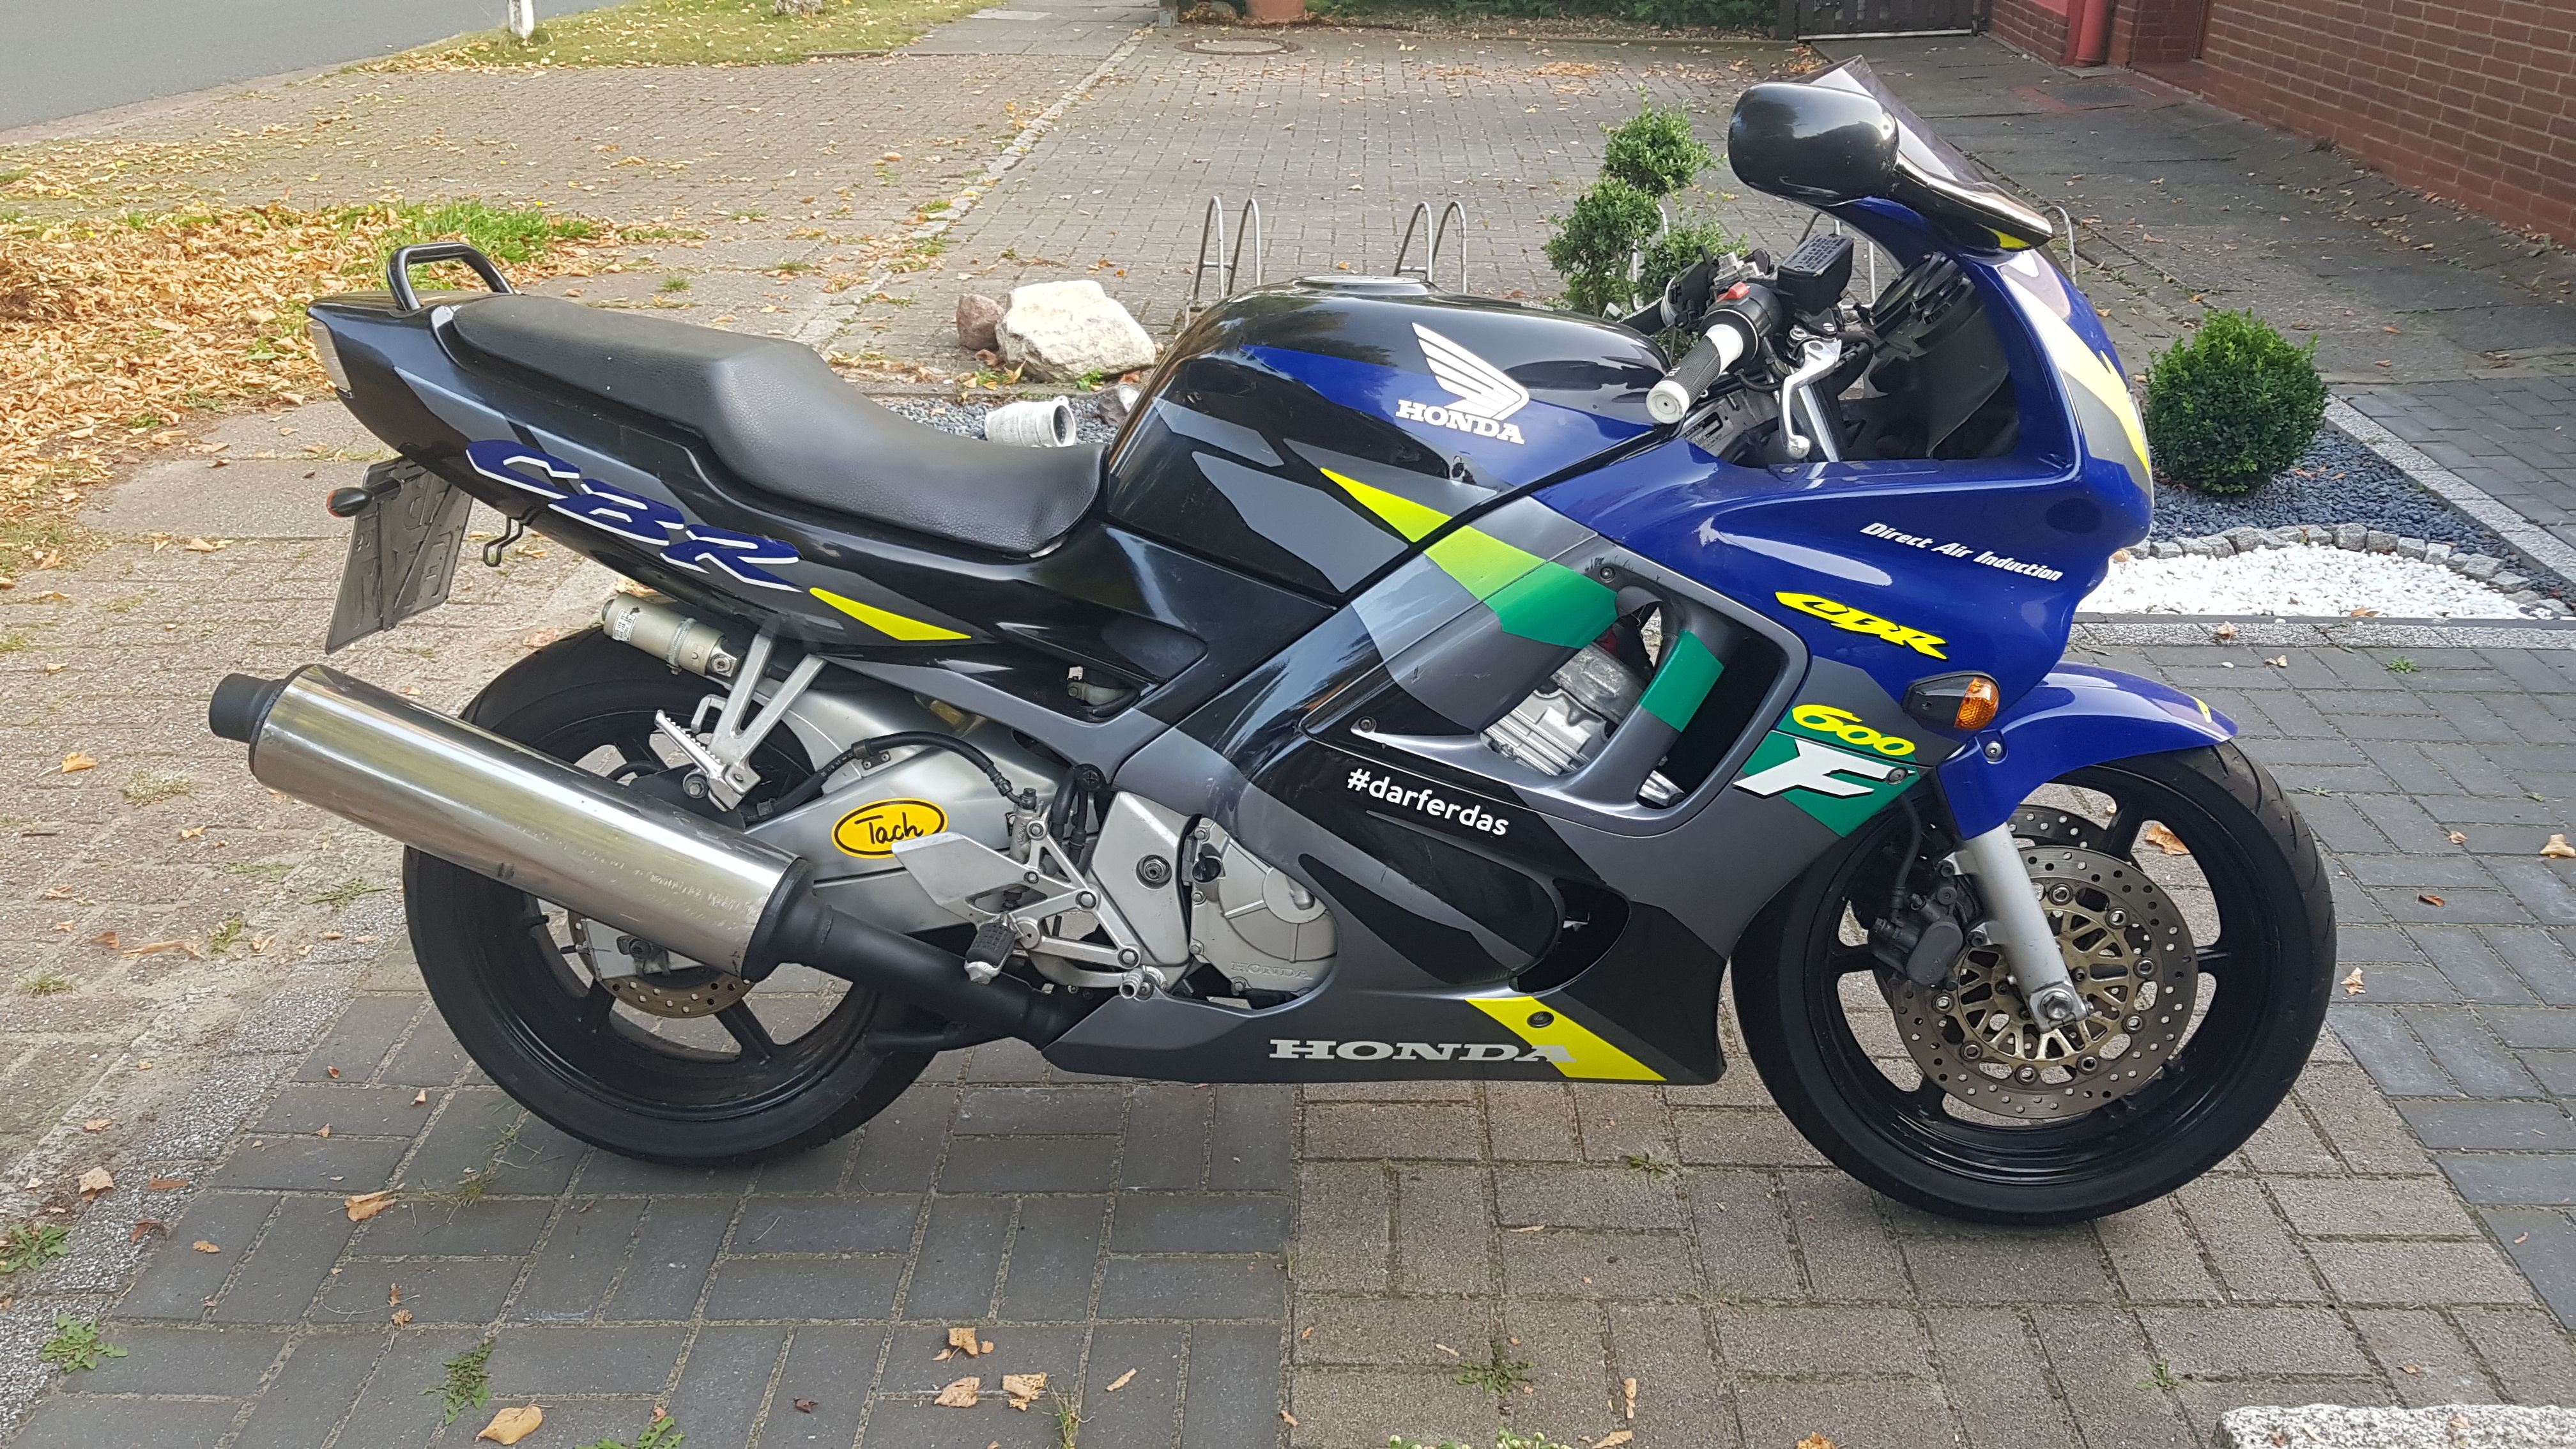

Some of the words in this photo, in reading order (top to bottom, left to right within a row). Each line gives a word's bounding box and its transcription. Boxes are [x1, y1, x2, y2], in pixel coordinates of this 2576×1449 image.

[1396, 399, 1525, 445] HONDA
[466, 440, 802, 592] CBR
[1860, 522, 1931, 549] Direct
[1931, 542, 1972, 558] Air
[1973, 551, 2064, 582] Induction
[1775, 592, 1949, 660] CBR
[1791, 704, 1915, 756] 600
[1732, 739, 1916, 797] F
[854, 811, 924, 845] Tach
[1347, 768, 1509, 836] #darferdas
[1230, 961, 1313, 980] HONDA
[1269, 1039, 1578, 1063] HONDA
